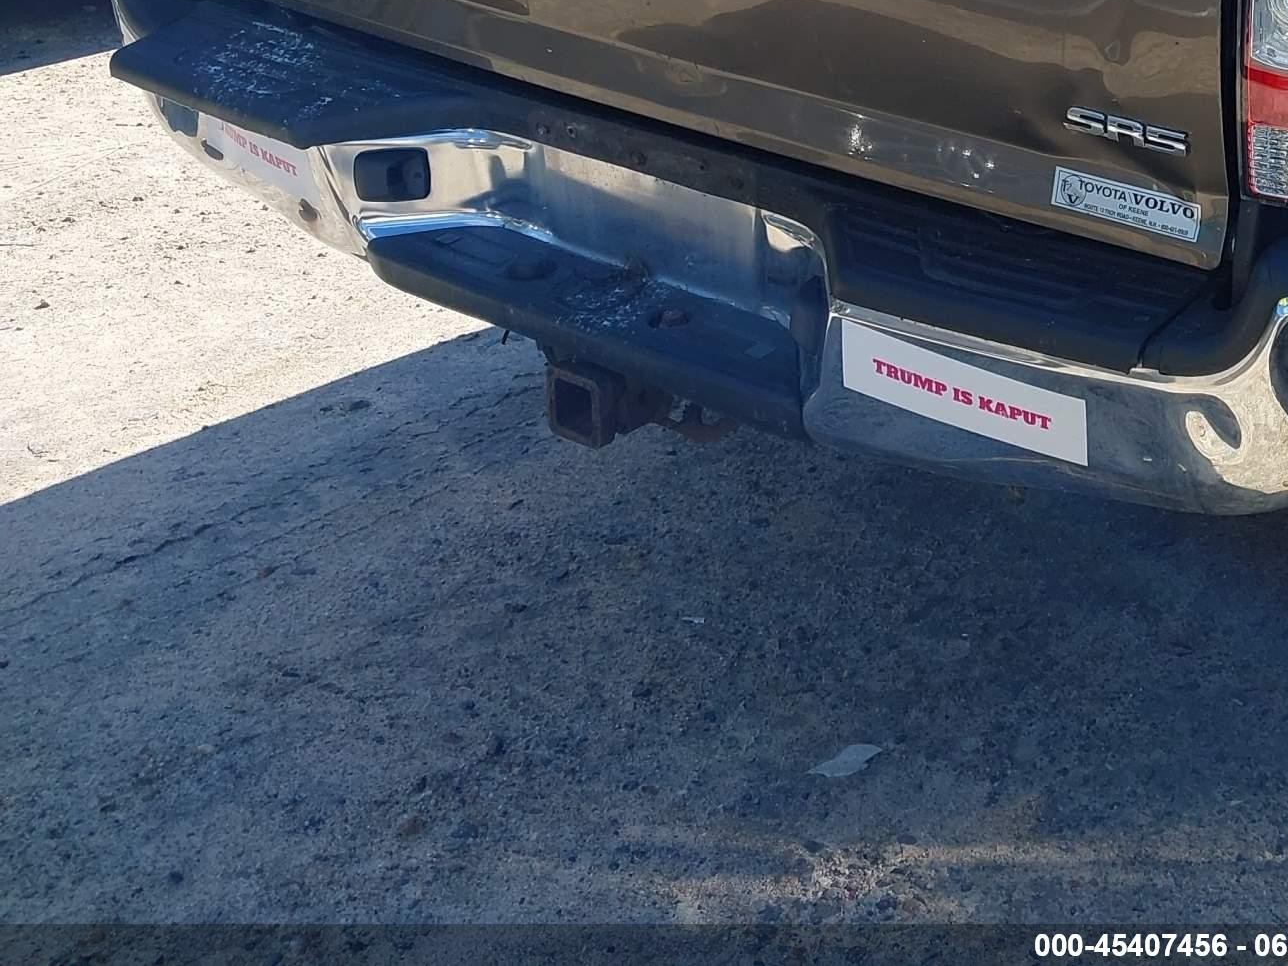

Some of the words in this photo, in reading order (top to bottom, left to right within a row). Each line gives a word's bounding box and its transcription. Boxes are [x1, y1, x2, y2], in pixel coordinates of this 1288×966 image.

[248, 141, 260, 157] IS
[260, 148, 298, 177] KAPUT
[1078, 179, 1128, 202] TOYOTA
[1129, 193, 1195, 220] VOLVO
[1118, 203, 1127, 211] OF
[1128, 205, 1149, 217] KEENE
[873, 358, 947, 396] TRUMP
[953, 387, 973, 405] IS
[978, 396, 1052, 430] KAPUT
